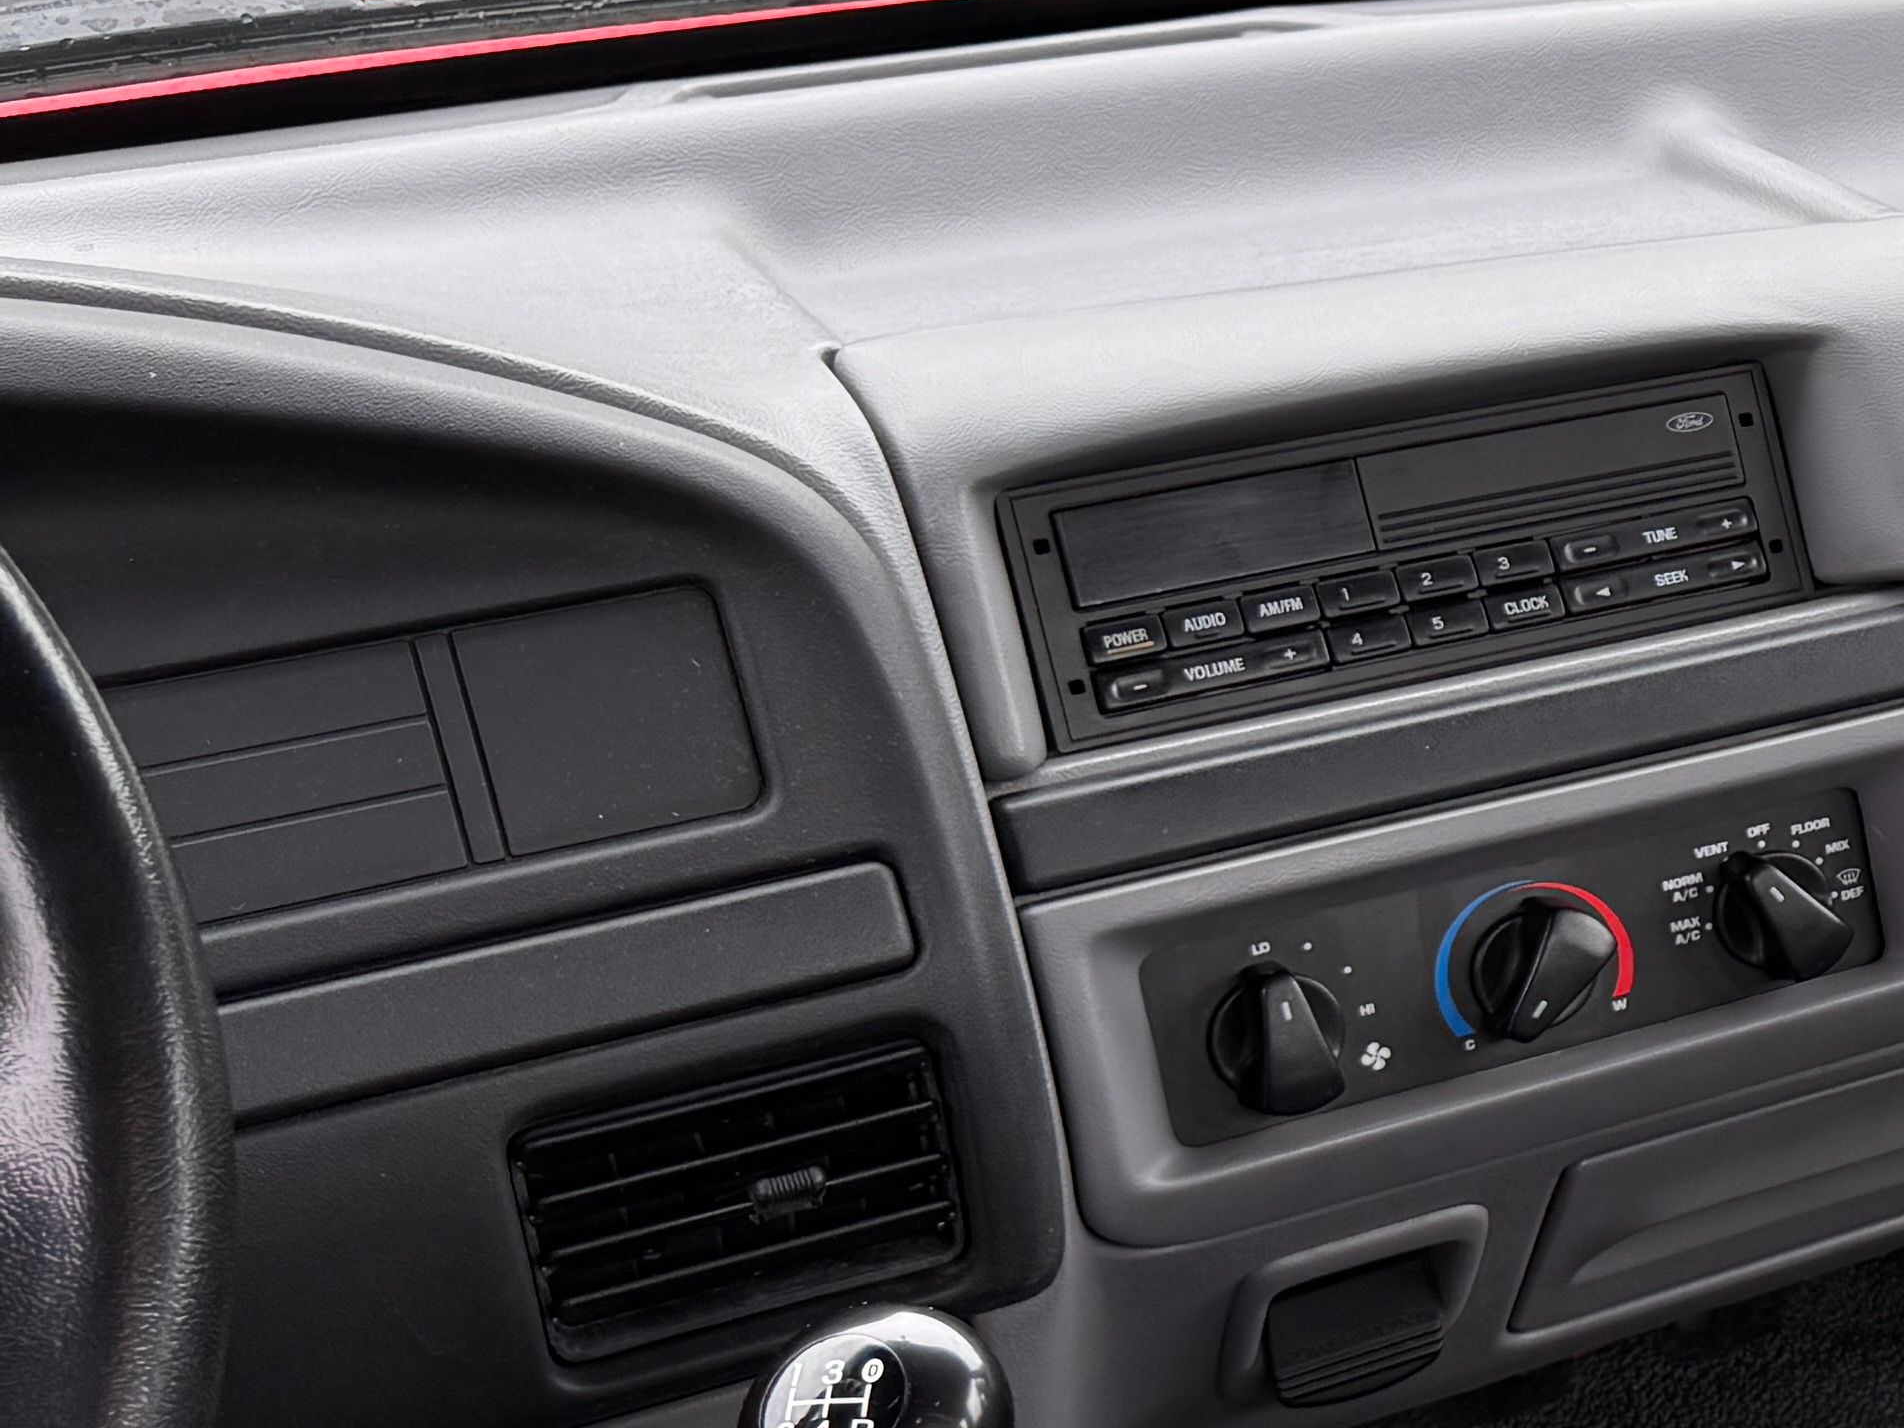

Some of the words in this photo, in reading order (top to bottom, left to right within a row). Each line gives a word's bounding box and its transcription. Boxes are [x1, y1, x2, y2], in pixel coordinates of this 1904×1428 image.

[1642, 527, 1678, 544] TUNE
[1497, 556, 1510, 570] 3
[1421, 572, 1434, 586] 2
[1654, 569, 1689, 587] SEEK
[1341, 587, 1350, 601] 1
[1259, 597, 1303, 617] AM/FM
[1504, 595, 1549, 615] CLOCK
[1184, 612, 1226, 632] AUDIO
[1431, 616, 1444, 630] 5
[1103, 628, 1149, 649] POWER
[1351, 632, 1363, 646] 4
[1184, 658, 1246, 681] VOLUME
[1746, 823, 1770, 838] OFF
[1790, 817, 1830, 836] FLOOR
[1694, 841, 1729, 859] VENT
[1825, 839, 1850, 854] MIX
[1662, 872, 1704, 892] NORM
[1673, 887, 1698, 903] A/C
[1840, 885, 1864, 901] DEF
[1670, 916, 1701, 933] MAX
[1675, 930, 1701, 945] A/C
[1251, 941, 1271, 956] LO
[1359, 1002, 1376, 1017] HI
[1612, 997, 1628, 1012] W
[1464, 1039, 1476, 1051] C
[791, 1362, 803, 1387] 1
[821, 1359, 845, 1385] 3
